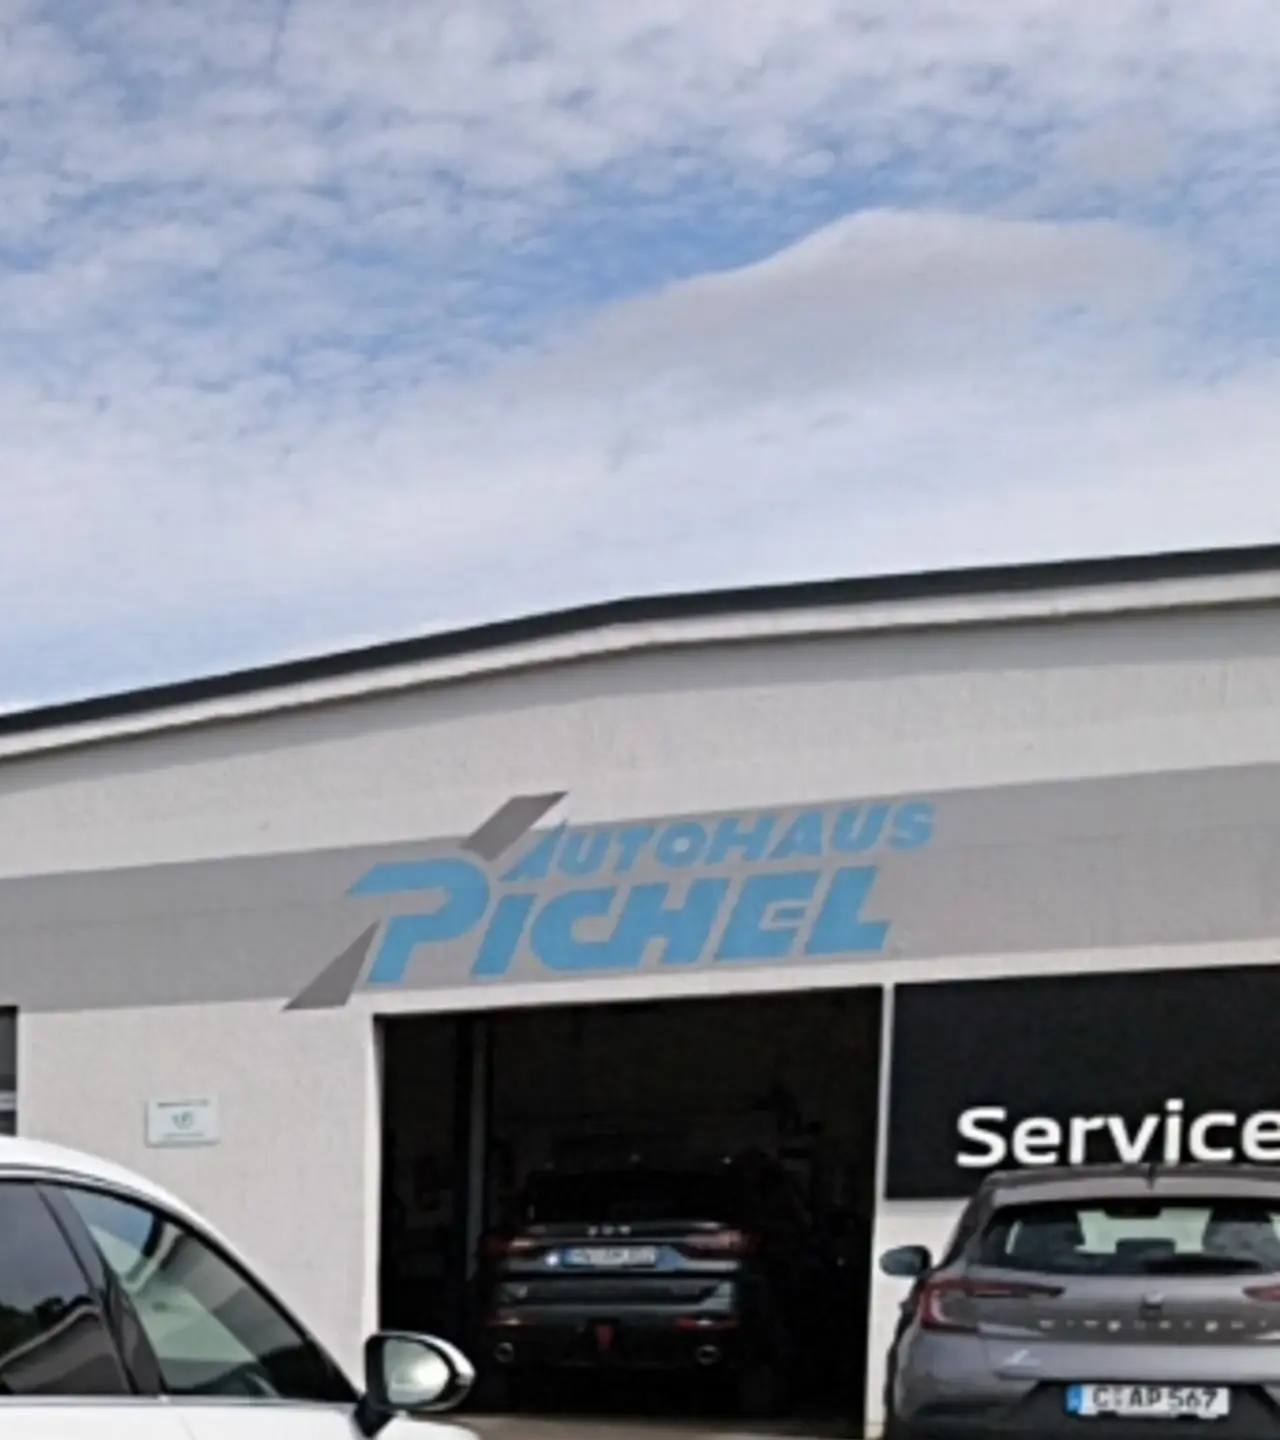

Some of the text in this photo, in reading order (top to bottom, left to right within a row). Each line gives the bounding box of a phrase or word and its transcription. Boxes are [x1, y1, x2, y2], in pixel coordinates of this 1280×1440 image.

[496, 797, 934, 883] AUTOHAUS
[345, 839, 892, 985] PICHEL
[954, 1098, 1280, 1169] Service
